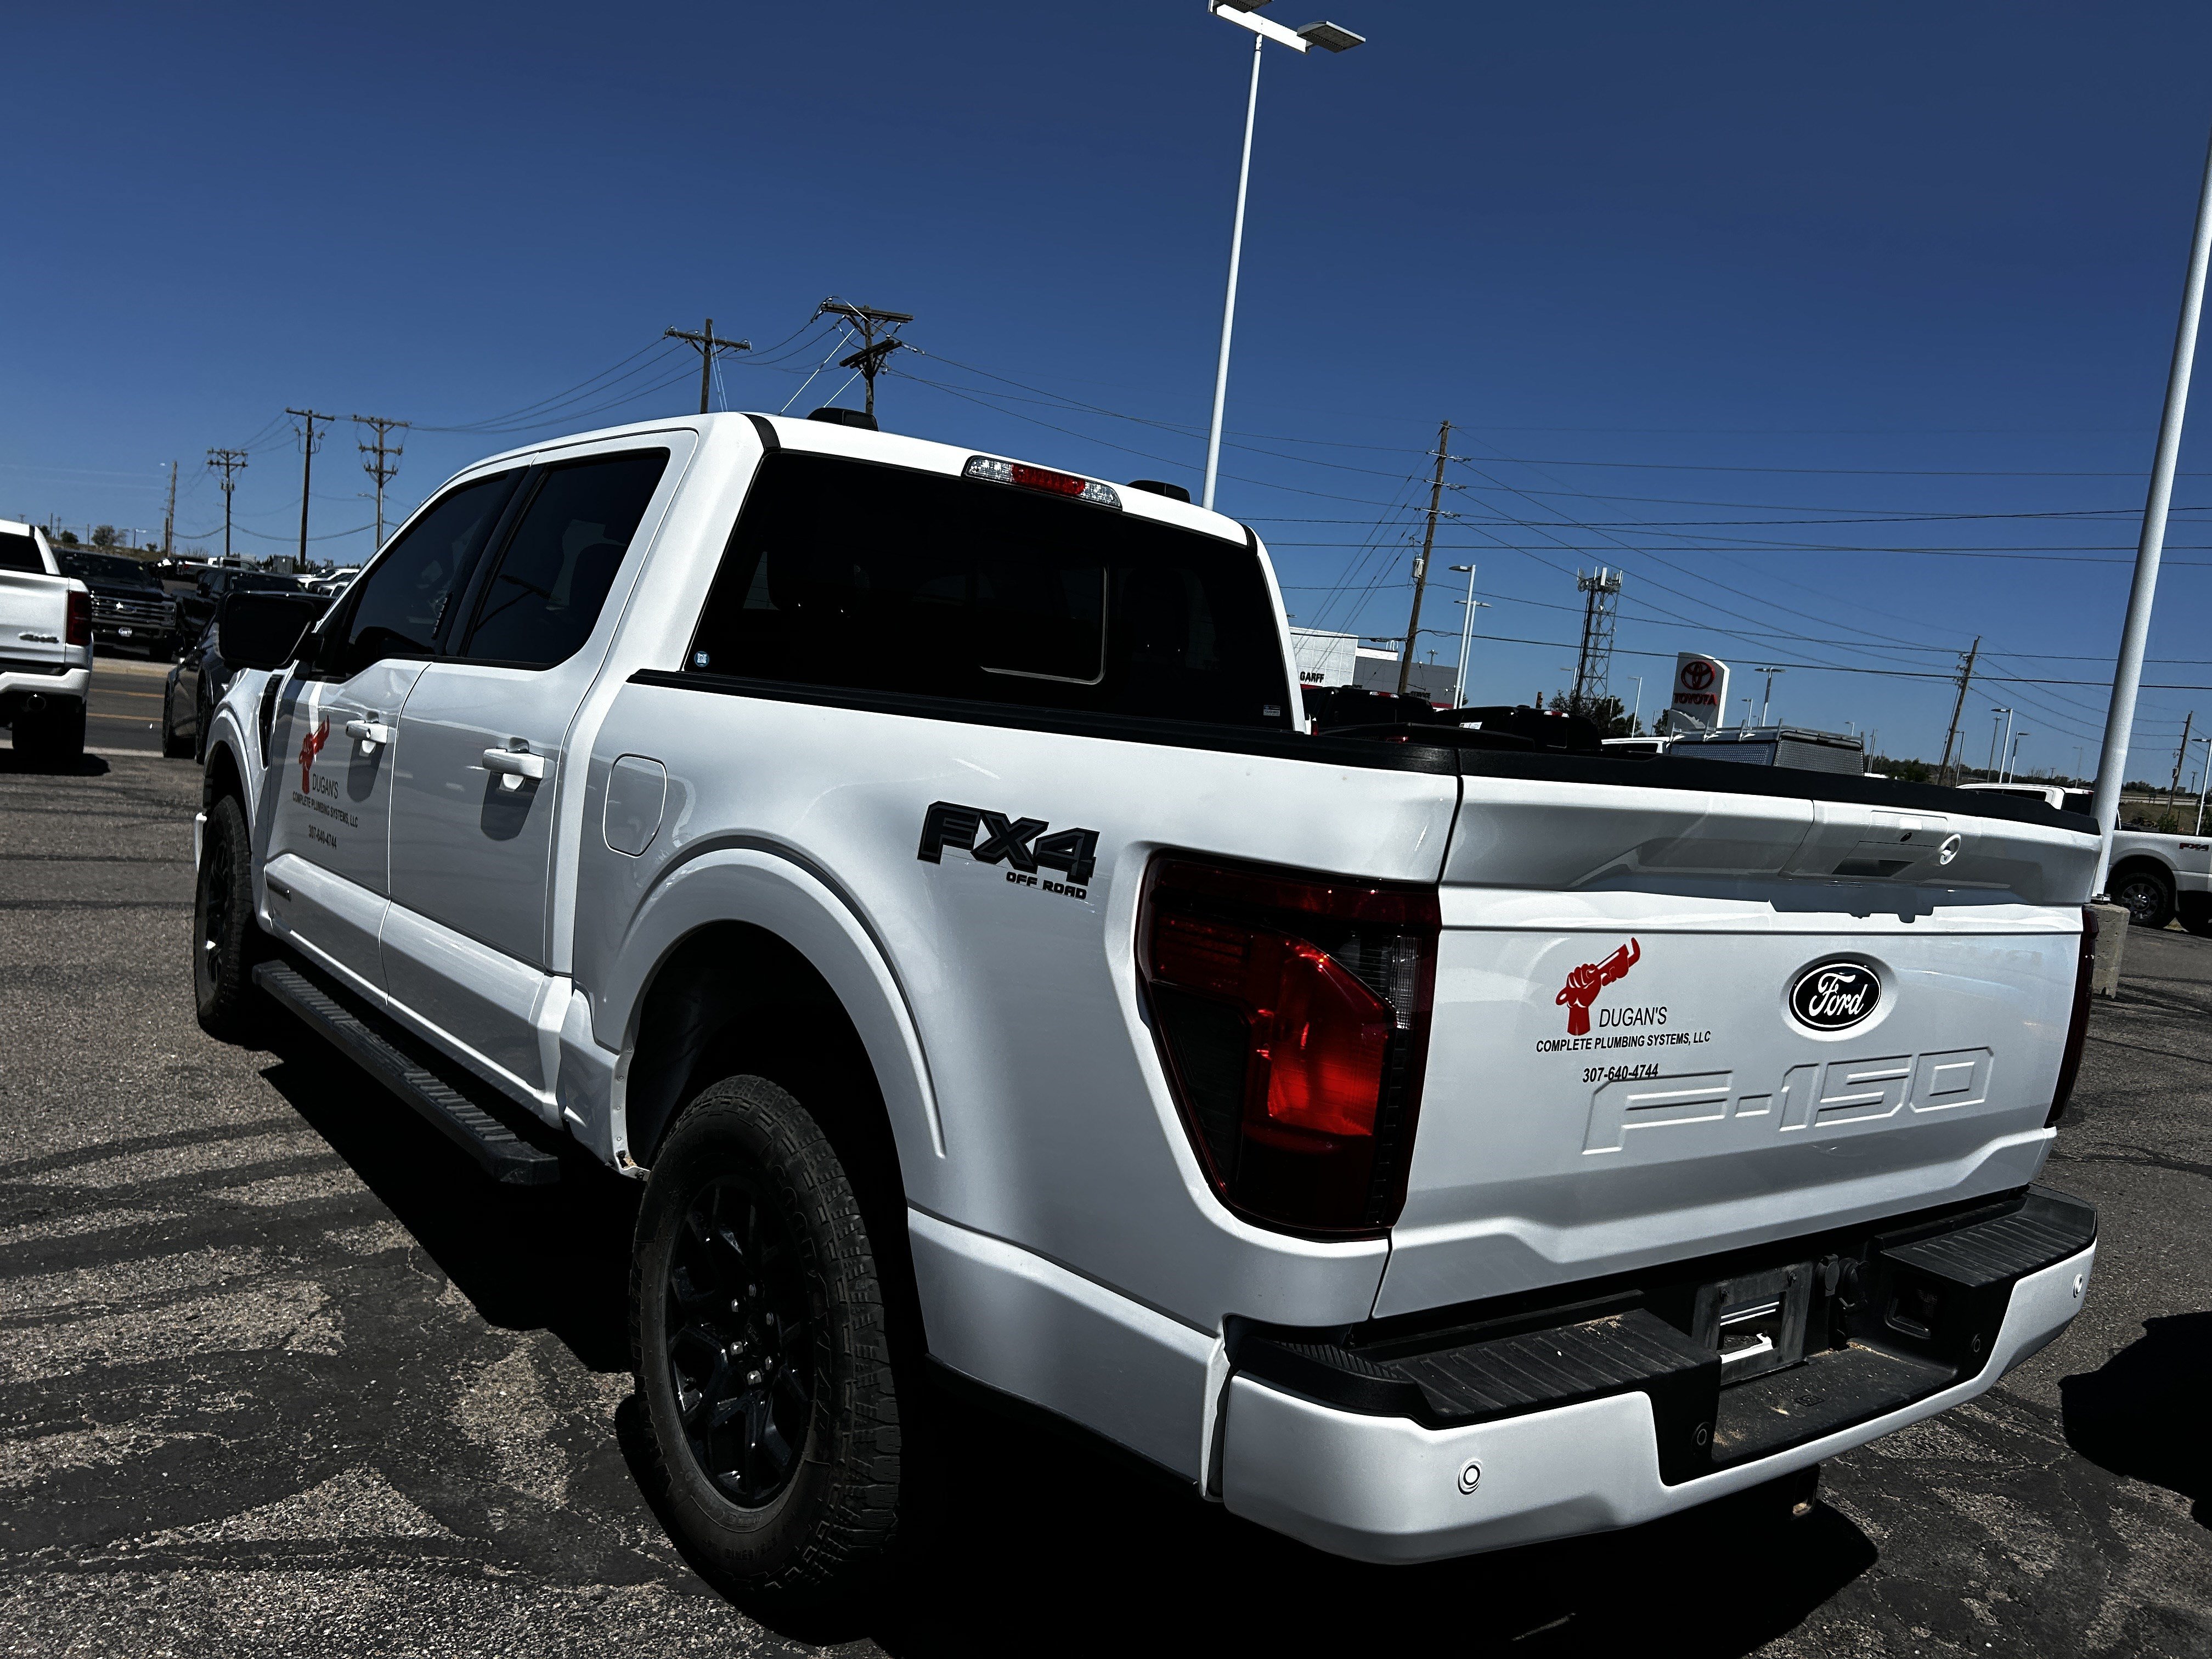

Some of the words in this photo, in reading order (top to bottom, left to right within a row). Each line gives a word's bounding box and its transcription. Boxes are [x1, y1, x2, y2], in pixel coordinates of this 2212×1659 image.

[1300, 671, 1324, 683] GARFF
[1673, 693, 1718, 706] TOYOTA
[312, 773, 338, 799] DUGAN'S
[292, 791, 311, 808] COMPLETE
[311, 799, 330, 816] PLUMBING
[330, 806, 349, 827] SYSTEMS,
[350, 814, 358, 828] LLC
[308, 823, 337, 850] 307-640-4744
[917, 800, 1100, 887] FX4
[1006, 871, 1037, 888] OFF
[1042, 879, 1087, 900] ROAD
[1808, 971, 1868, 1019] Ford
[1599, 1006, 1667, 1028] DUGAN'S
[1536, 1037, 1592, 1053] COMPLETE
[1595, 1035, 1645, 1050] PLUMBING
[1647, 1032, 1691, 1047] SYSTEMS,
[1694, 1031, 1711, 1043] LLC
[1582, 1063, 1658, 1083] 307-640-4744
[1582, 1046, 1994, 1155] F-150
